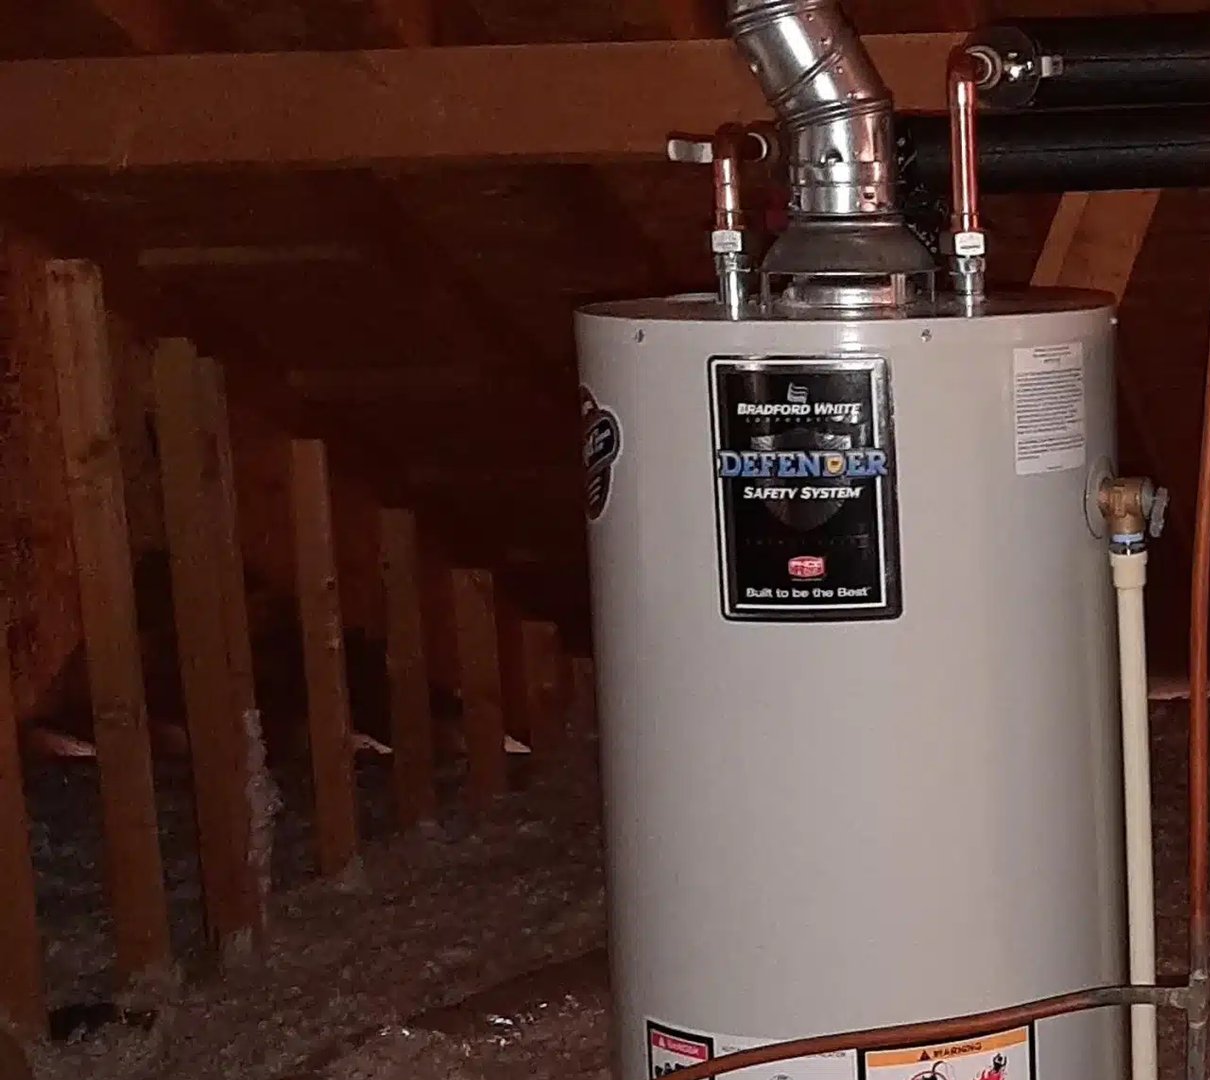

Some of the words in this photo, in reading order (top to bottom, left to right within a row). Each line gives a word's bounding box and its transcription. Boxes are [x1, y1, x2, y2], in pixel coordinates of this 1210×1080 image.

[737, 402, 811, 415] BRADFORD
[814, 402, 861, 415] WHITE
[719, 450, 888, 478] DEFENDER
[743, 487, 798, 499] SAFETY
[800, 486, 863, 499] SYSTEM
[746, 587, 774, 598] Built
[776, 588, 789, 598] to
[792, 587, 809, 598] be
[812, 587, 834, 598] the
[837, 587, 869, 598] Best
